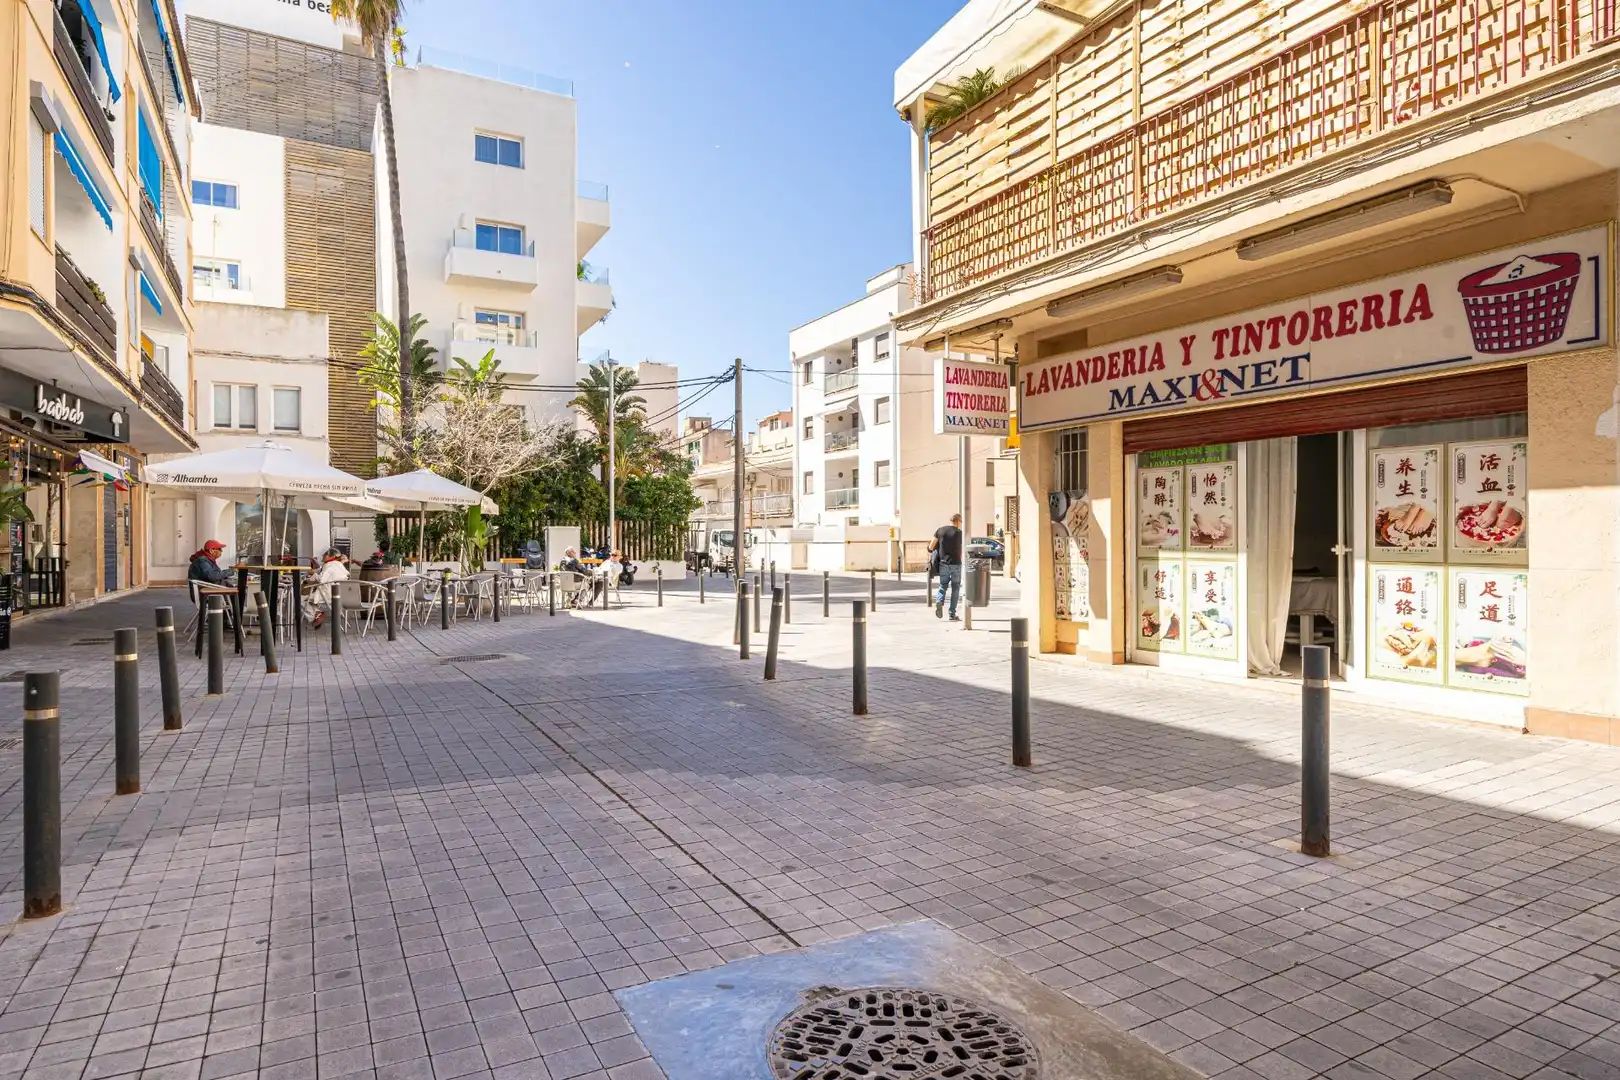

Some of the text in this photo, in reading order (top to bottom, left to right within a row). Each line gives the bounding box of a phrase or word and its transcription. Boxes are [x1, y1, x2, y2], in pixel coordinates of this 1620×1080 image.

[1025, 283, 1434, 397] LAVANDERIA Y TINTORERIA
[945, 366, 1008, 389] LAVANDERIA
[945, 391, 1008, 413] TINTORERIA
[171, 473, 218, 484] Alhambra
[1203, 473, 1218, 506] 怡然
[1395, 457, 1417, 498] 养生
[1476, 453, 1503, 494] 活血
[1204, 570, 1218, 604] 享受
[1479, 581, 1503, 623] 足道
